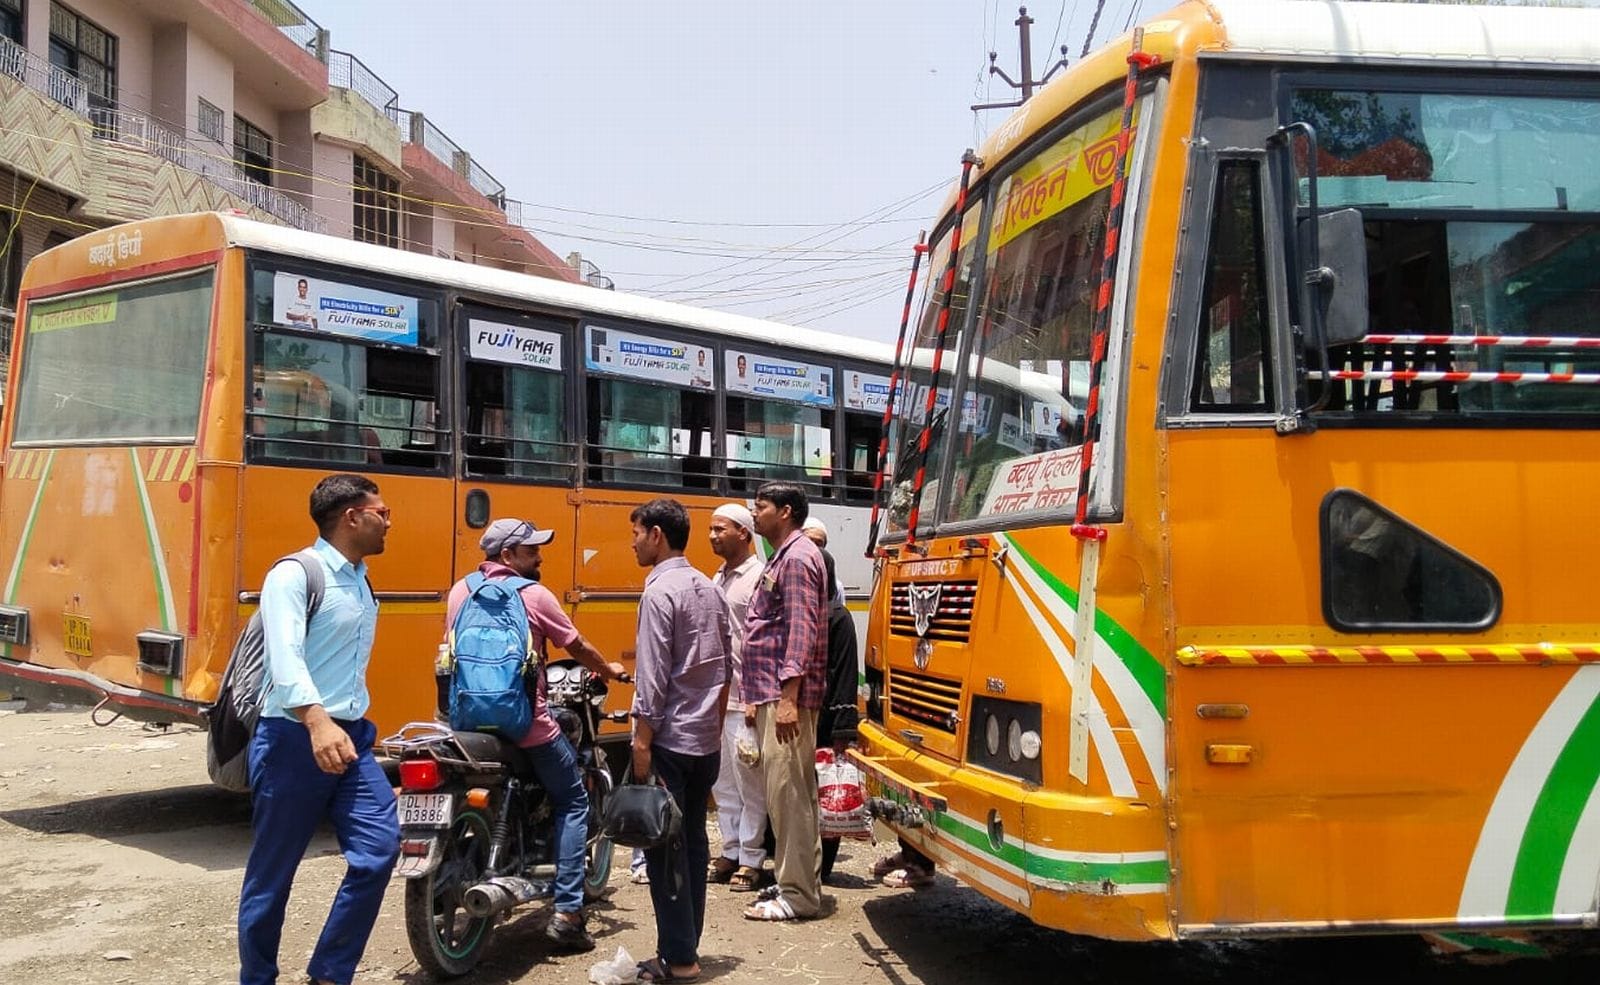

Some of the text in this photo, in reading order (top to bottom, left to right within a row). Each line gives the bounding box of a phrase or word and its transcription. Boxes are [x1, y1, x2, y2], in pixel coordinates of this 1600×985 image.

[993, 154, 1077, 239] रिवहन
[117, 229, 142, 260] डिपो
[378, 320, 407, 330] SOLAR
[522, 353, 552, 365] SOLAR
[910, 560, 949, 577] UPSRTC
[406, 795, 445, 809] DL11P
